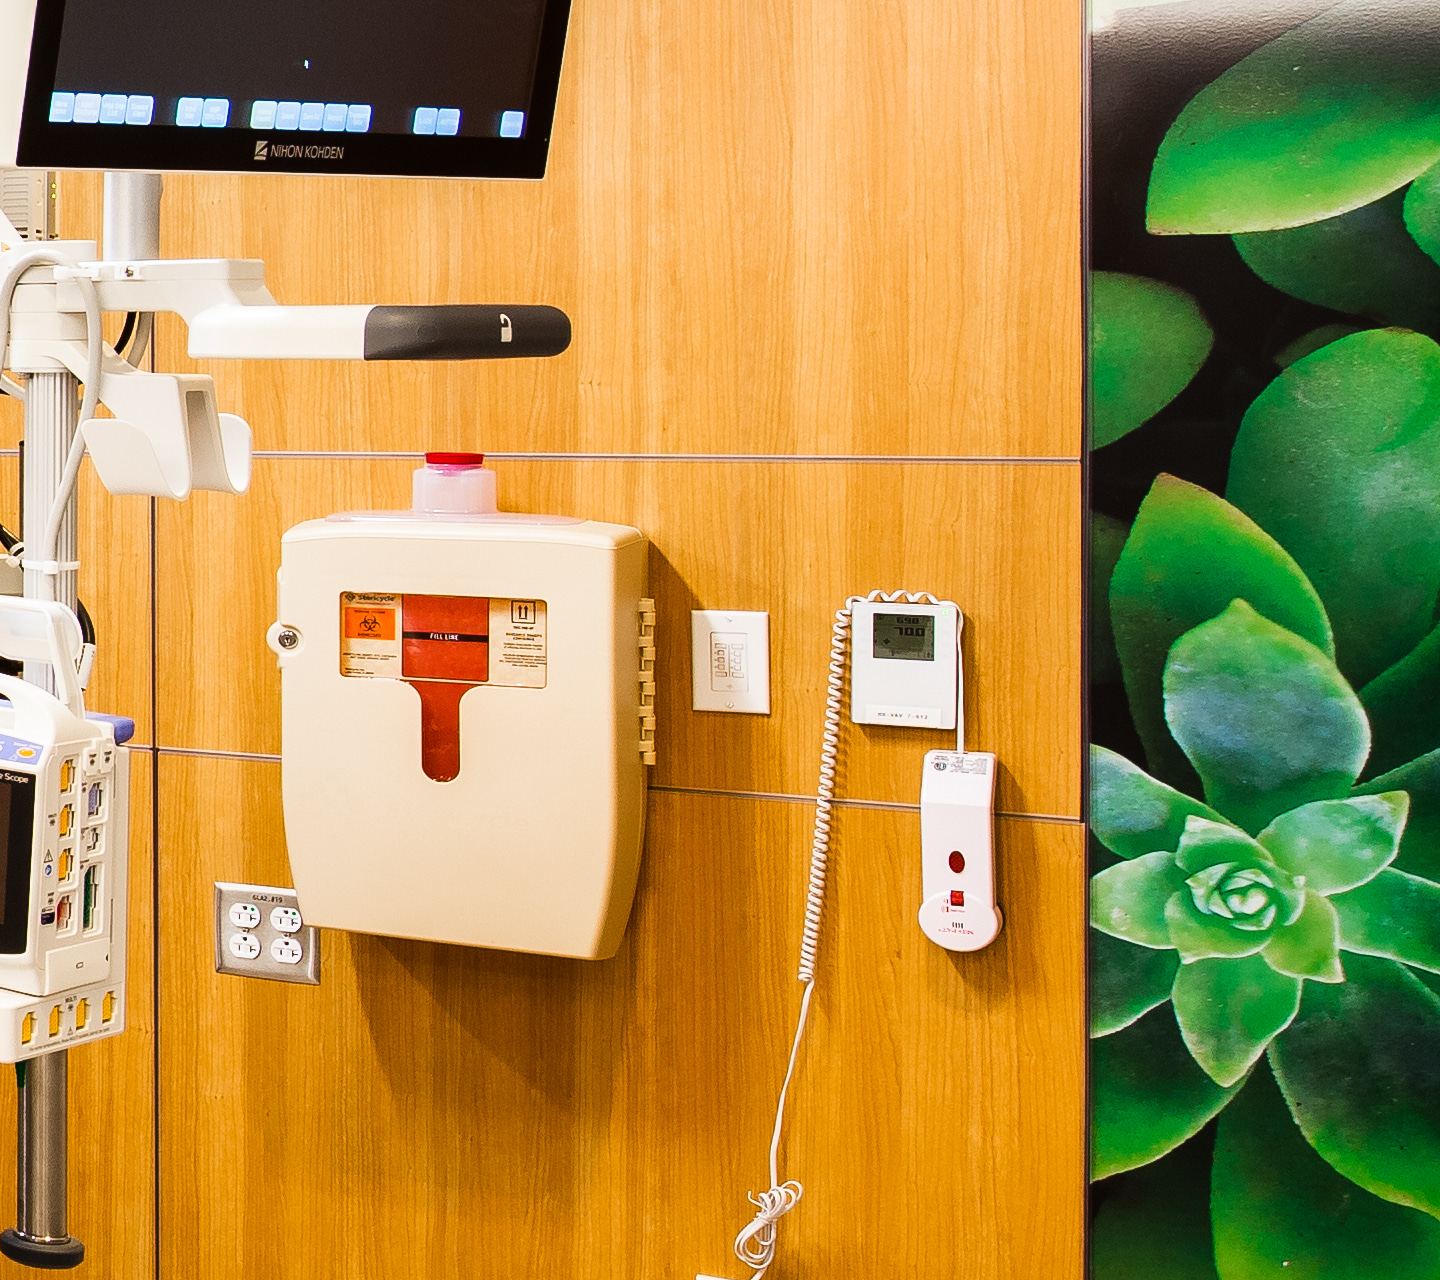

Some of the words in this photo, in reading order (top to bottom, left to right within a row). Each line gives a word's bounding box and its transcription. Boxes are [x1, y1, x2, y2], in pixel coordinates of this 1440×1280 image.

[270, 144, 303, 158] NIHON
[304, 145, 345, 159] KOHDEN
[358, 594, 395, 602] Stericycle
[430, 632, 443, 641] FILL
[445, 633, 459, 641] LINE
[4, 772, 29, 785] Scope
